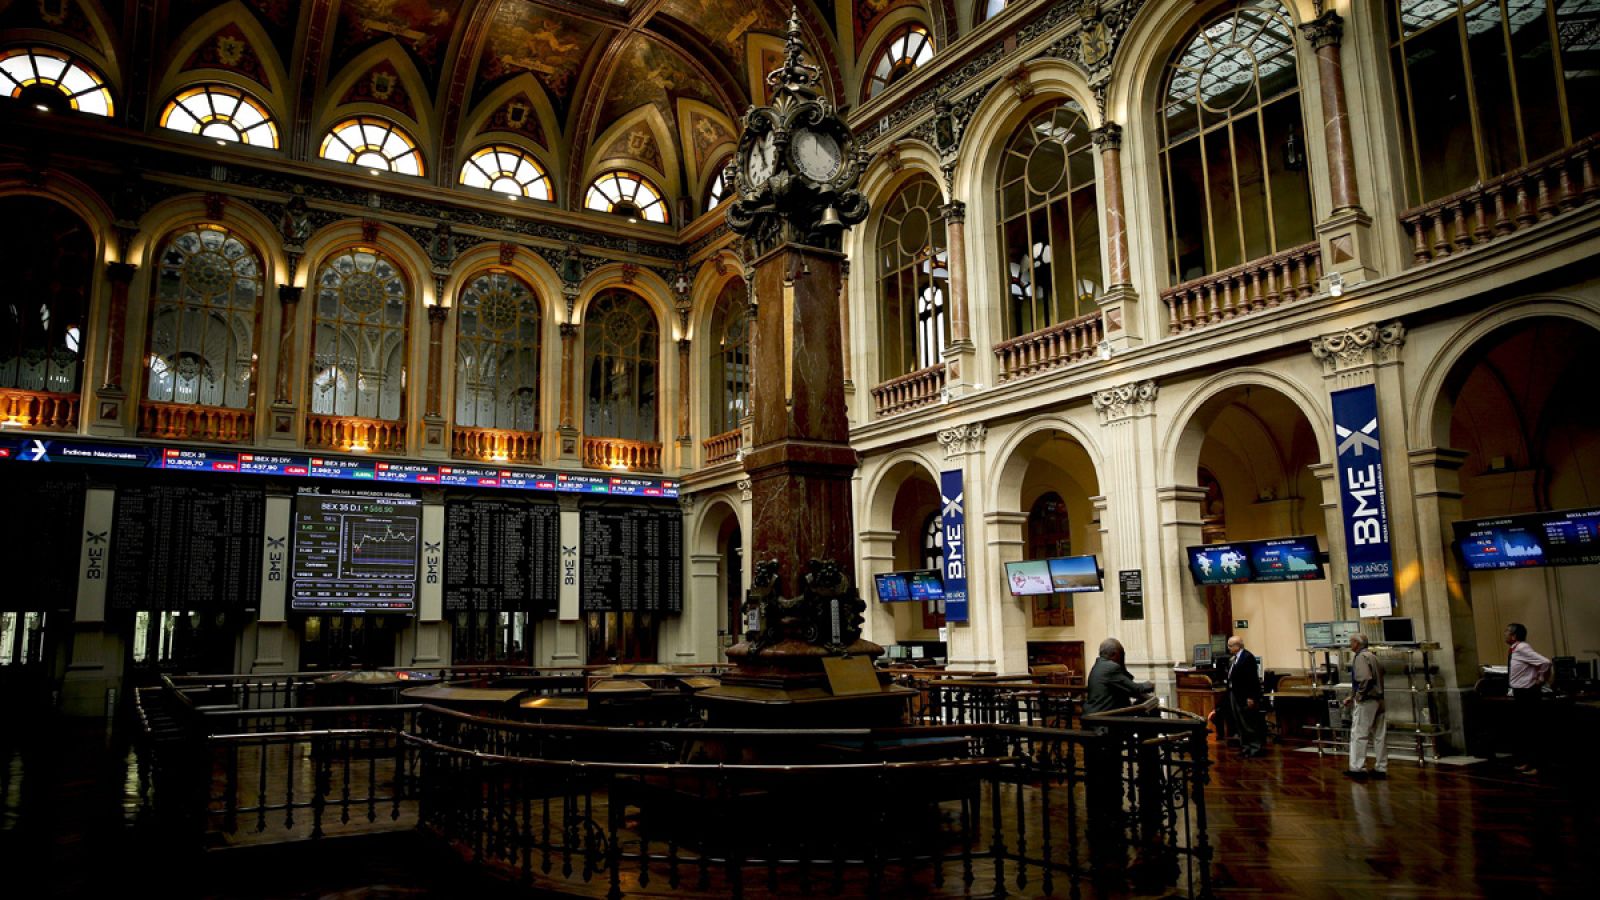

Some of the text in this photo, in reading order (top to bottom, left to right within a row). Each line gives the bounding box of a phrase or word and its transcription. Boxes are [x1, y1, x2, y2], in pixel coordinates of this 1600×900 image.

[93, 451, 137, 460] Nacionales
[180, 451, 197, 459] IBEX
[1347, 464, 1381, 546] BME
[87, 547, 102, 579] BME
[268, 551, 281, 581] BME
[947, 524, 962, 580] BME
[427, 556, 438, 584] BME
[565, 560, 576, 585] BME
[1351, 562, 1389, 574] 180 AÑOS
